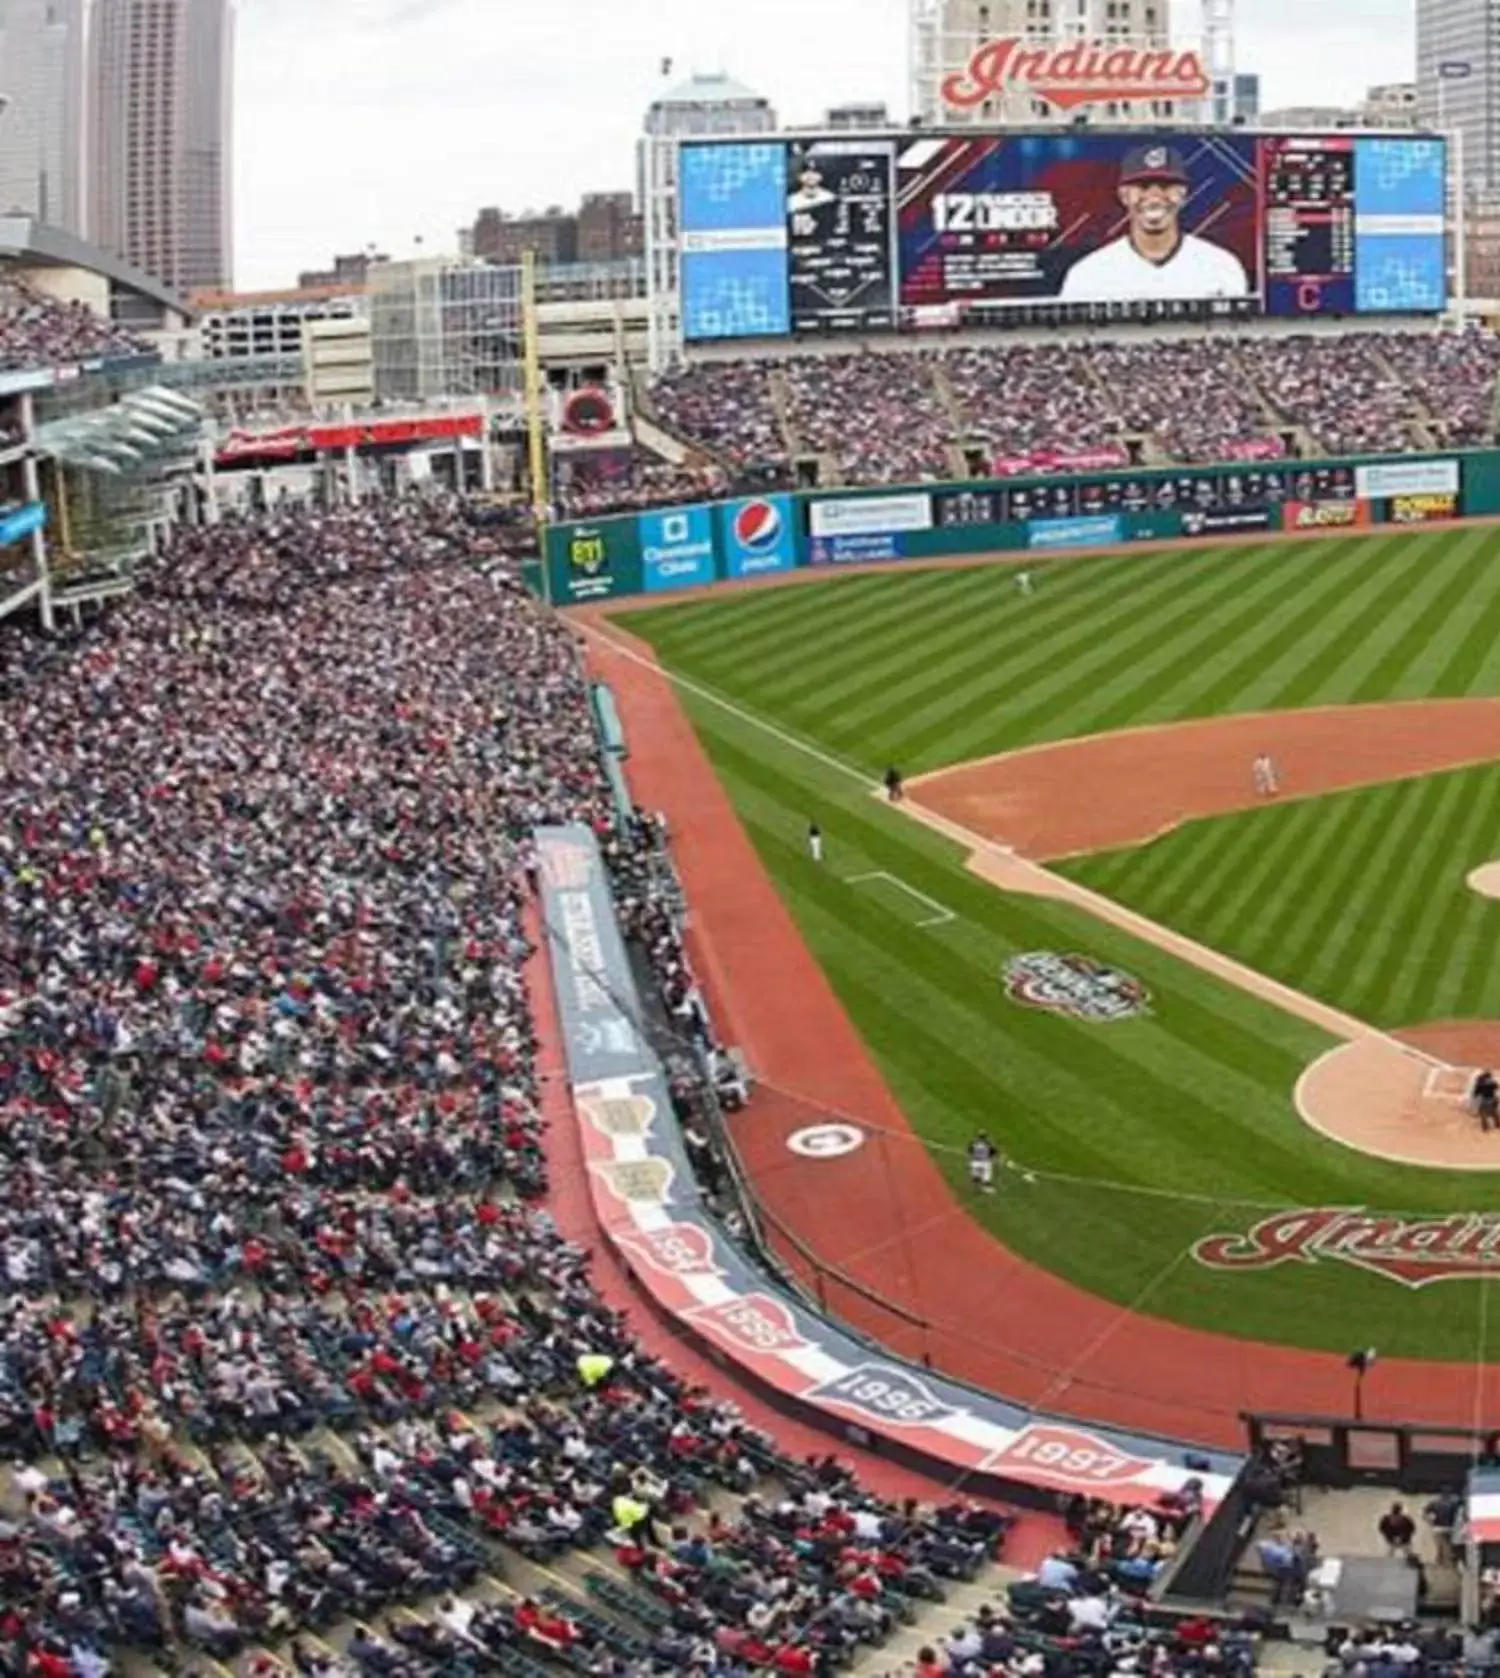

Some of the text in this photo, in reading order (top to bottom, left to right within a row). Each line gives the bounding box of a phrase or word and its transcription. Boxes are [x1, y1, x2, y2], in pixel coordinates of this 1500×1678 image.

[941, 37, 1209, 109] Indians
[932, 193, 974, 230] 12
[836, 1374, 933, 1419] 1996
[1012, 1436, 1128, 1480] 1997
